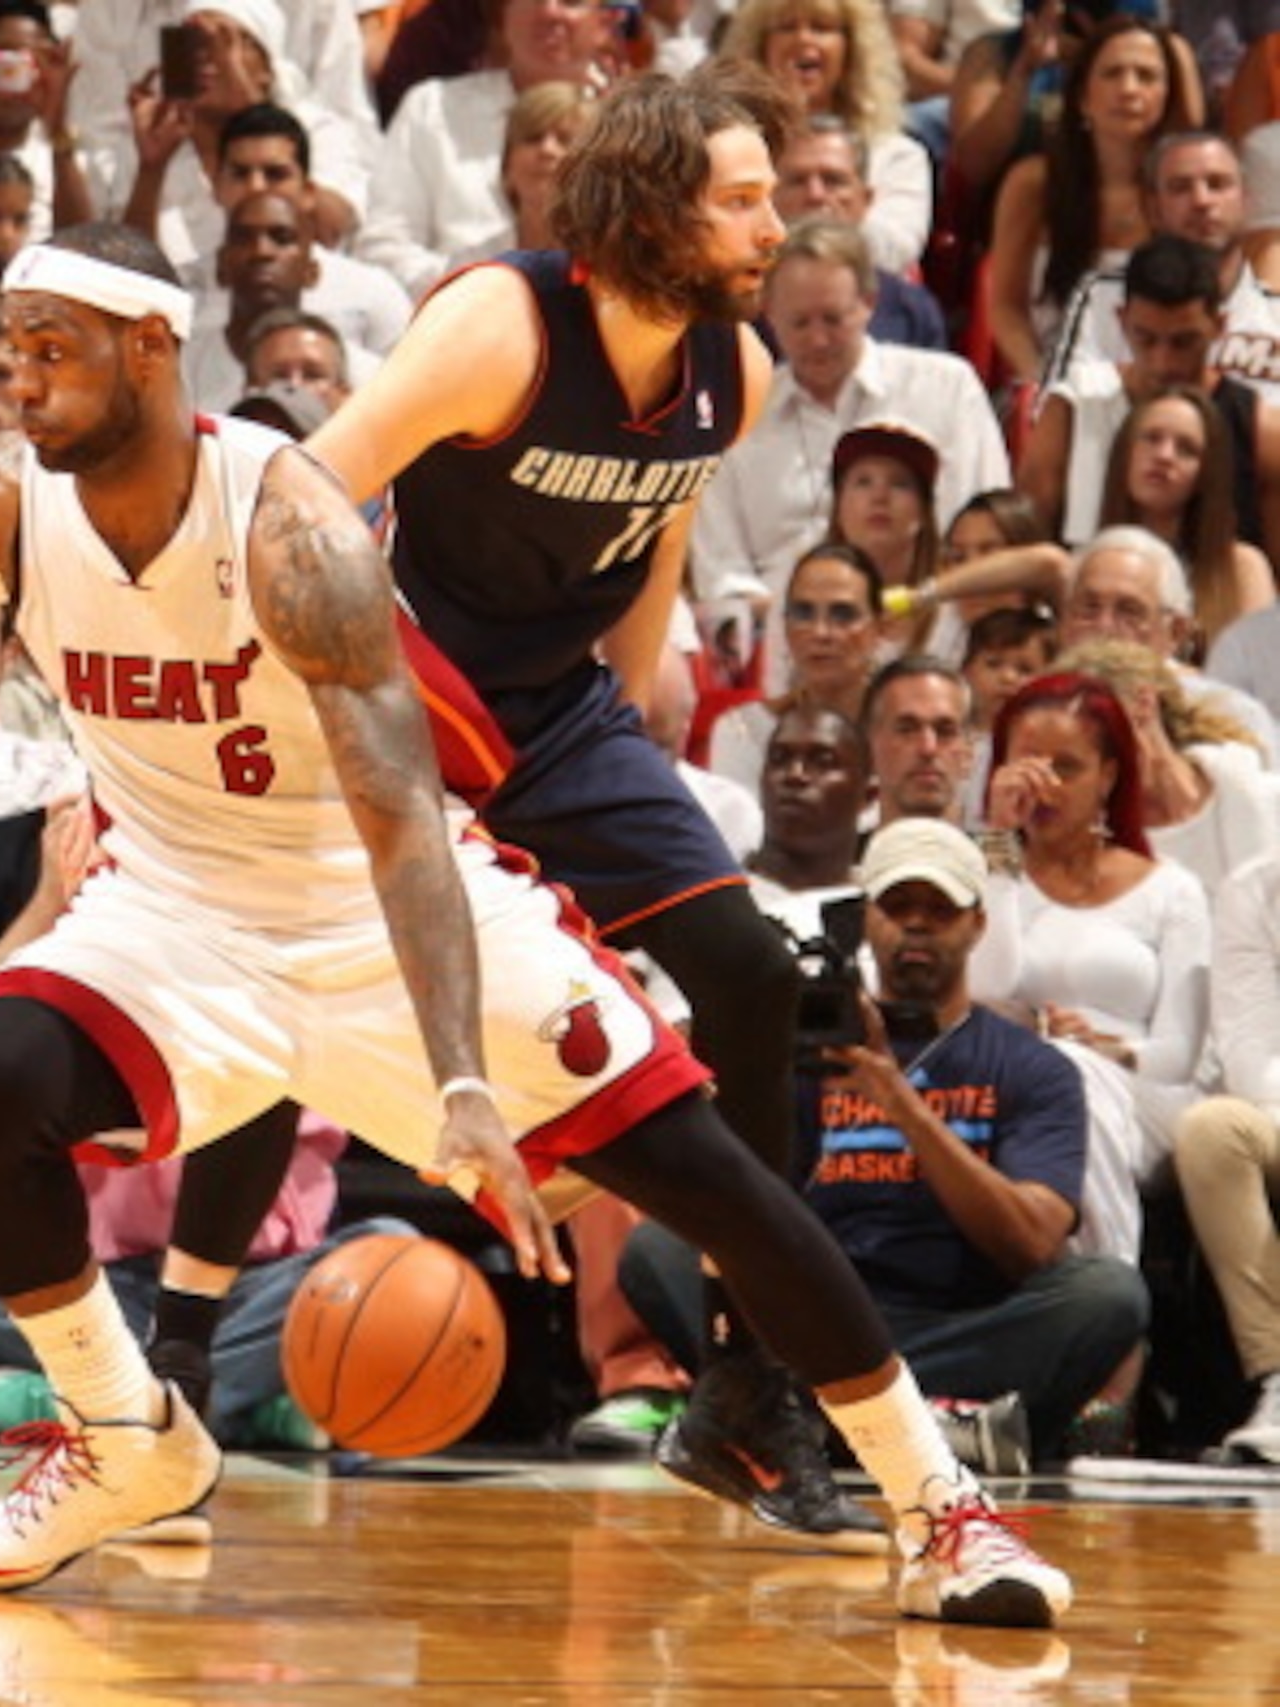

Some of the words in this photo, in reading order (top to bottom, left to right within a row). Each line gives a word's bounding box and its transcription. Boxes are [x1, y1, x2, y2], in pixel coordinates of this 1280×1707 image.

[510, 446, 721, 503] CHARLOTTE
[63, 638, 263, 724] HEAT
[217, 725, 275, 796] 6
[822, 1084, 999, 1127] CHAOTTE
